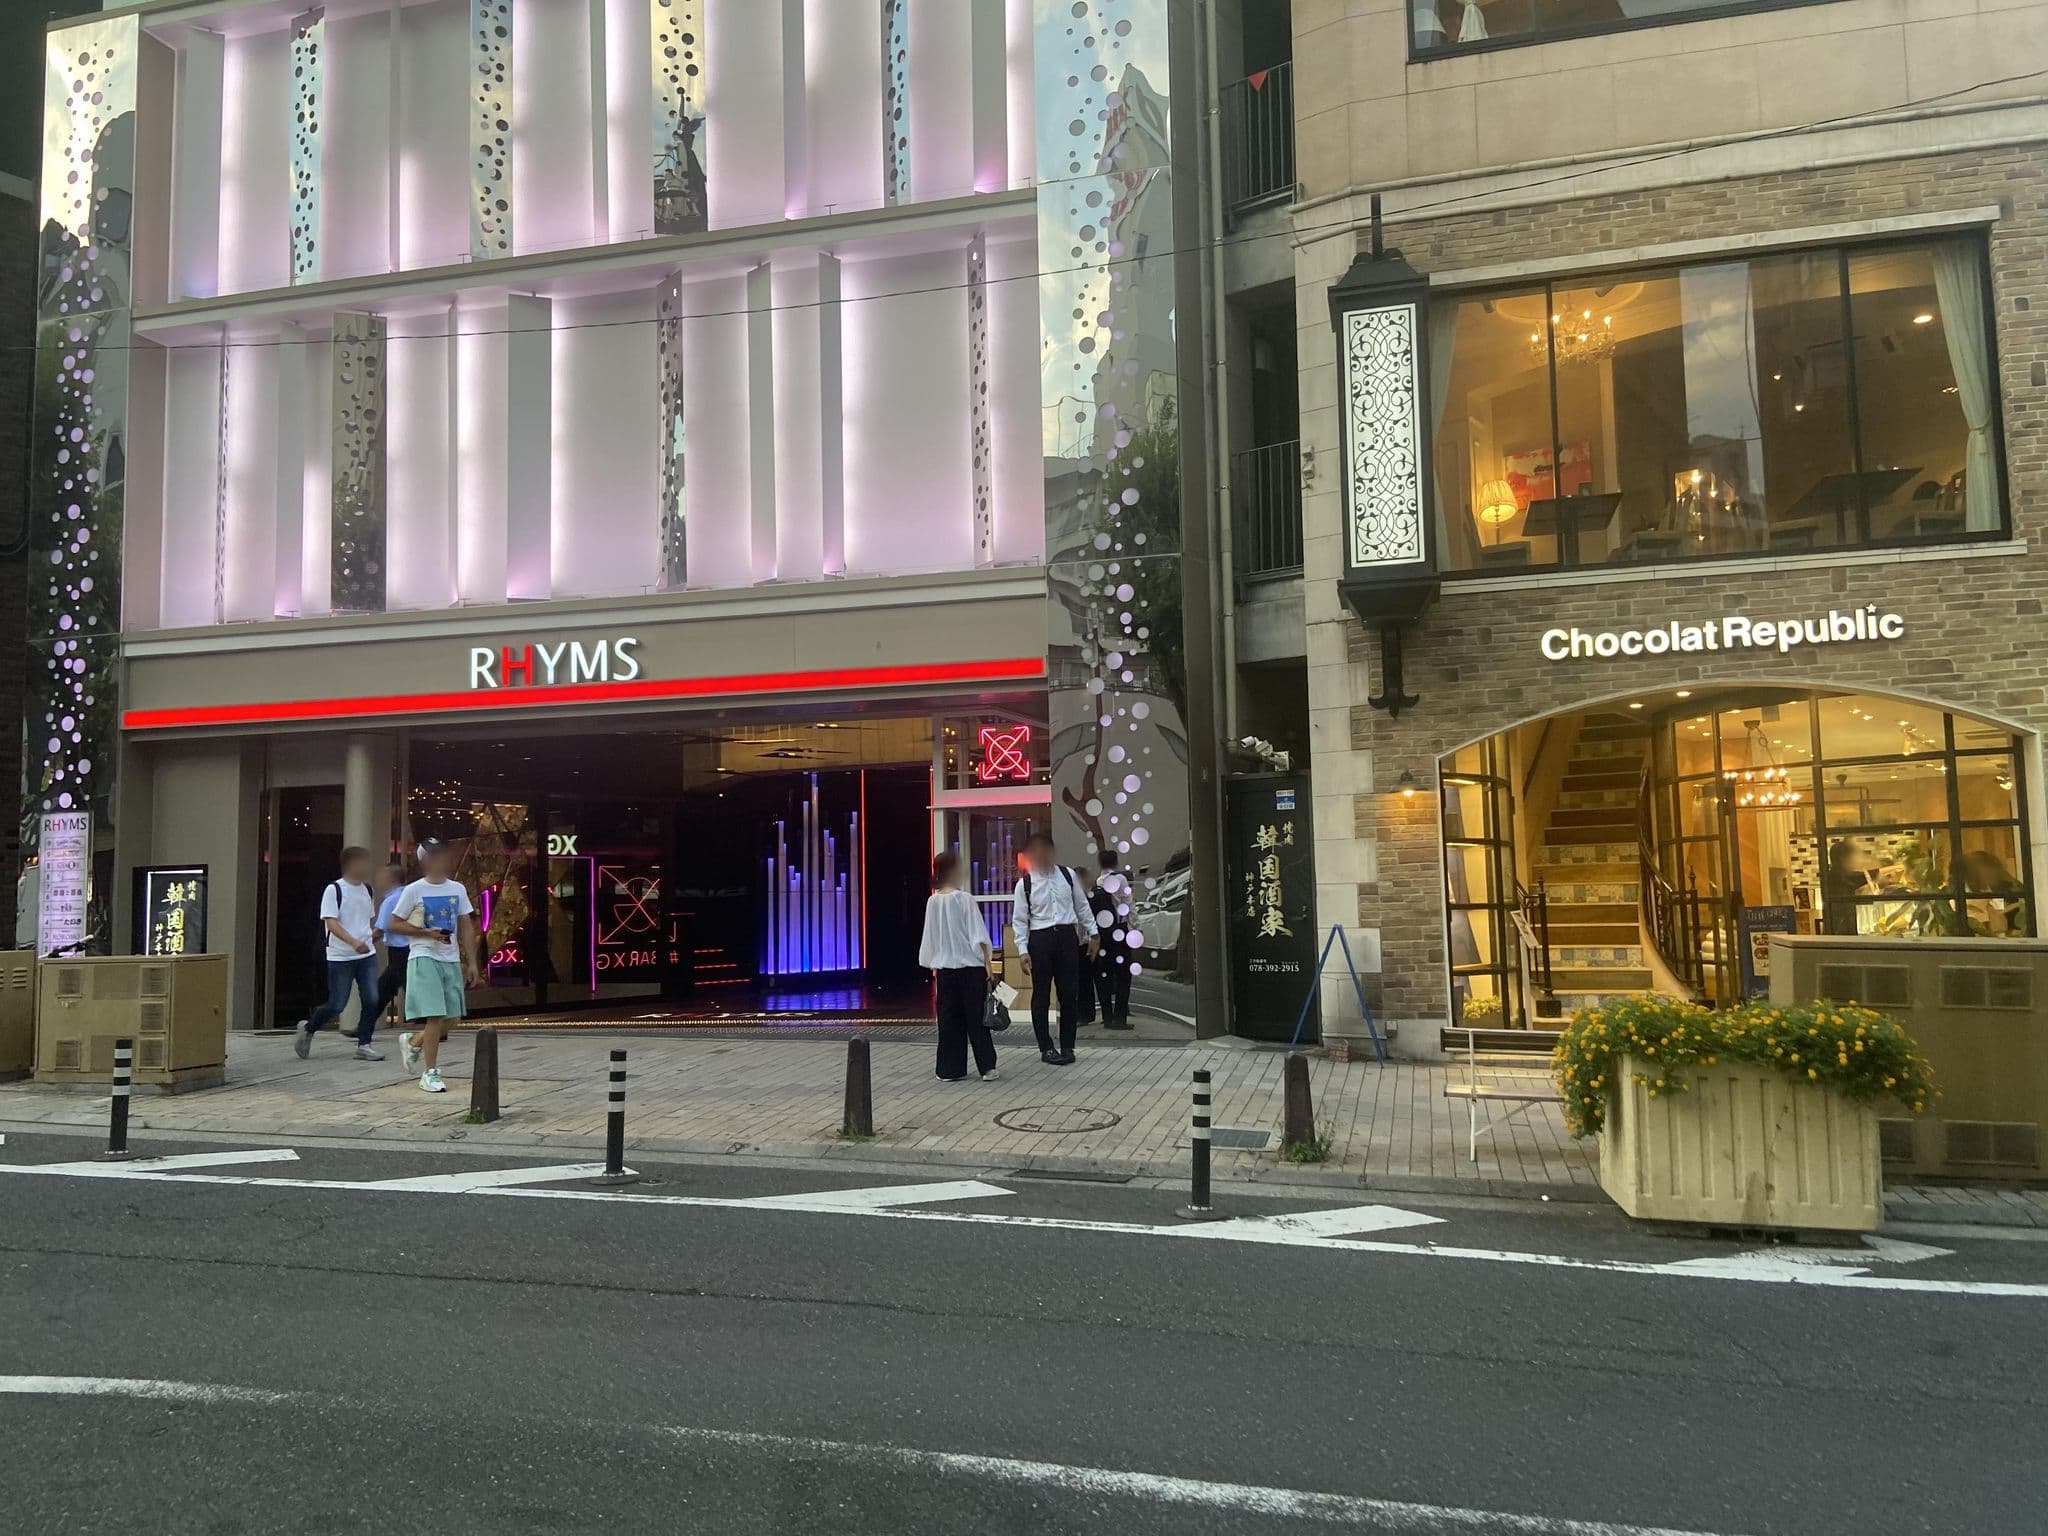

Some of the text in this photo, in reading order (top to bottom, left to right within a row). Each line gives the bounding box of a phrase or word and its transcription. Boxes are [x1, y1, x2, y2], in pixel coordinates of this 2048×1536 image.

[1541, 603, 1904, 660] Chocolat Republic
[470, 637, 640, 689] RHYMS
[44, 817, 87, 831] RHYMS
[154, 923, 164, 956] 神戸本
[160, 882, 188, 956] 韓国酒
[1249, 964, 1300, 973] 078-392-2915
